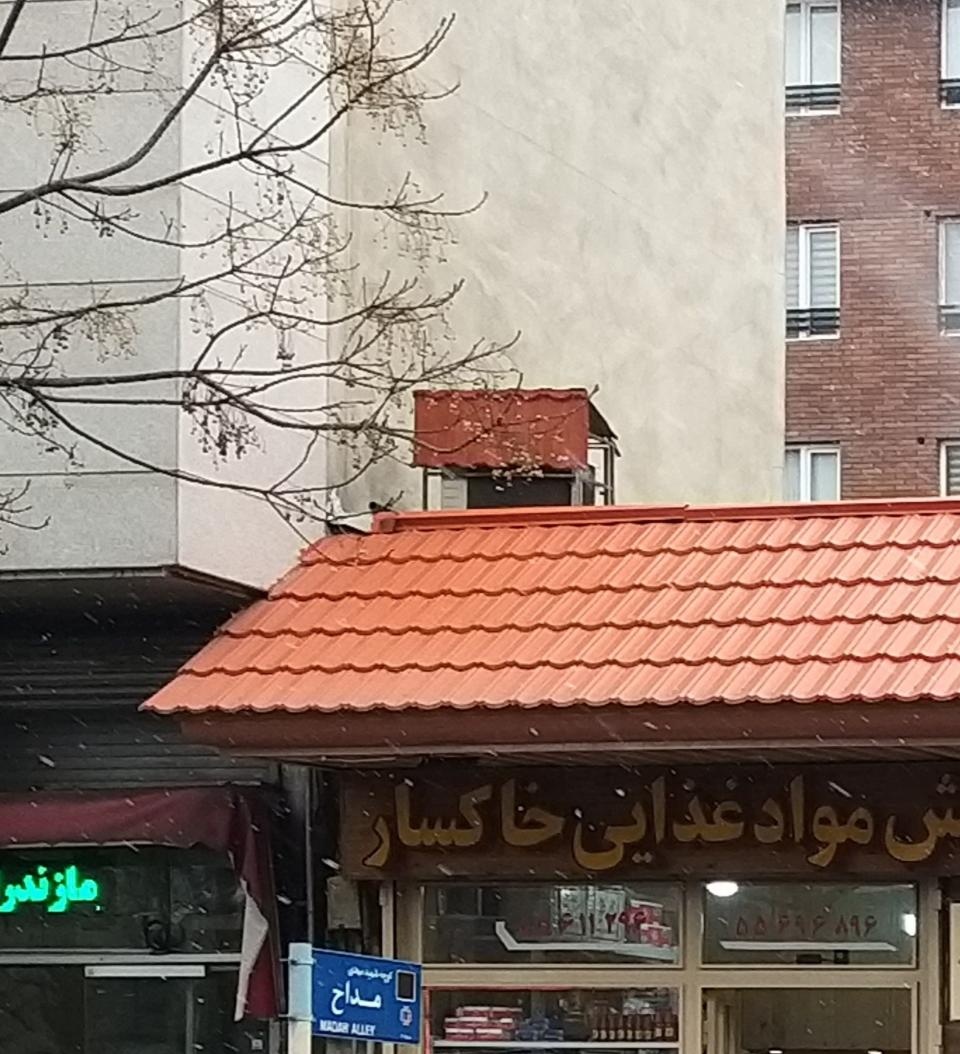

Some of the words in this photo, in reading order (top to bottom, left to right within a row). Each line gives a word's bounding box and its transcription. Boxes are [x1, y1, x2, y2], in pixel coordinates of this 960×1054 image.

[362, 781, 566, 867] خاکسار
[573, 776, 743, 870] غذایی
[753, 776, 875, 866] مواد
[331, 980, 382, 1016] مداح
[351, 1022, 377, 1036] ALLEY
